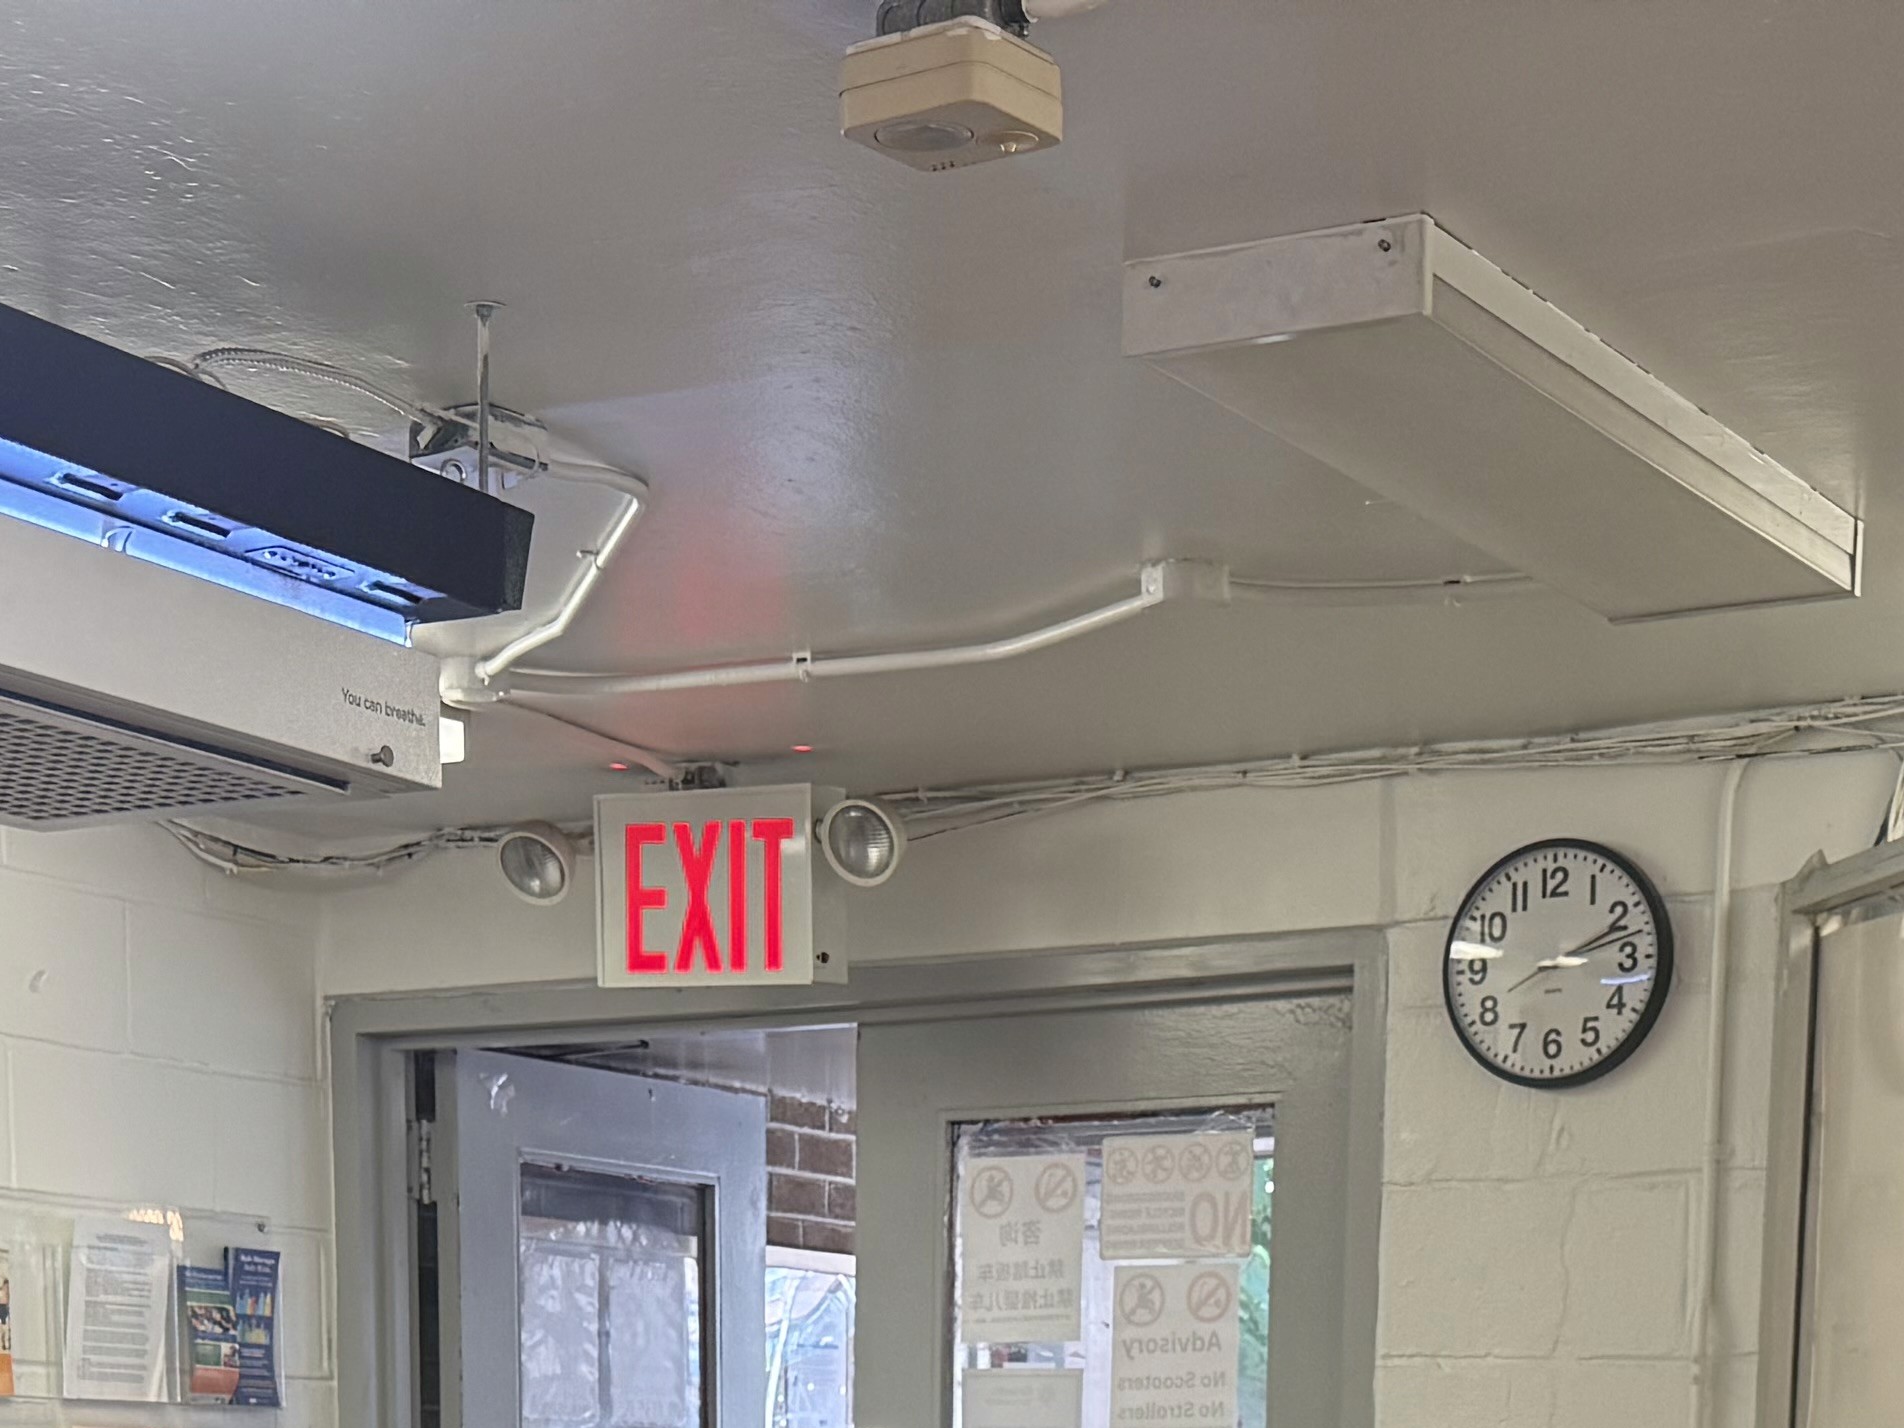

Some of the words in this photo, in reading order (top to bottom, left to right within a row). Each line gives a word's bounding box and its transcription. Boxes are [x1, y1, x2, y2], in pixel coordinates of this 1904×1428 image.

[625, 816, 795, 975] EXIT
[1511, 880, 1528, 913] 11
[1541, 866, 1569, 899] 12
[1589, 874, 1596, 905] 1
[1480, 911, 1507, 945] 10
[1608, 900, 1629, 932] 2
[1467, 957, 1488, 986] 9
[1617, 941, 1639, 973] 3
[1479, 995, 1499, 1027] 8
[1605, 984, 1627, 1016] 4
[1508, 1022, 1527, 1054] 7
[1542, 1028, 1563, 1060] 6
[1580, 1016, 1600, 1047] 5
